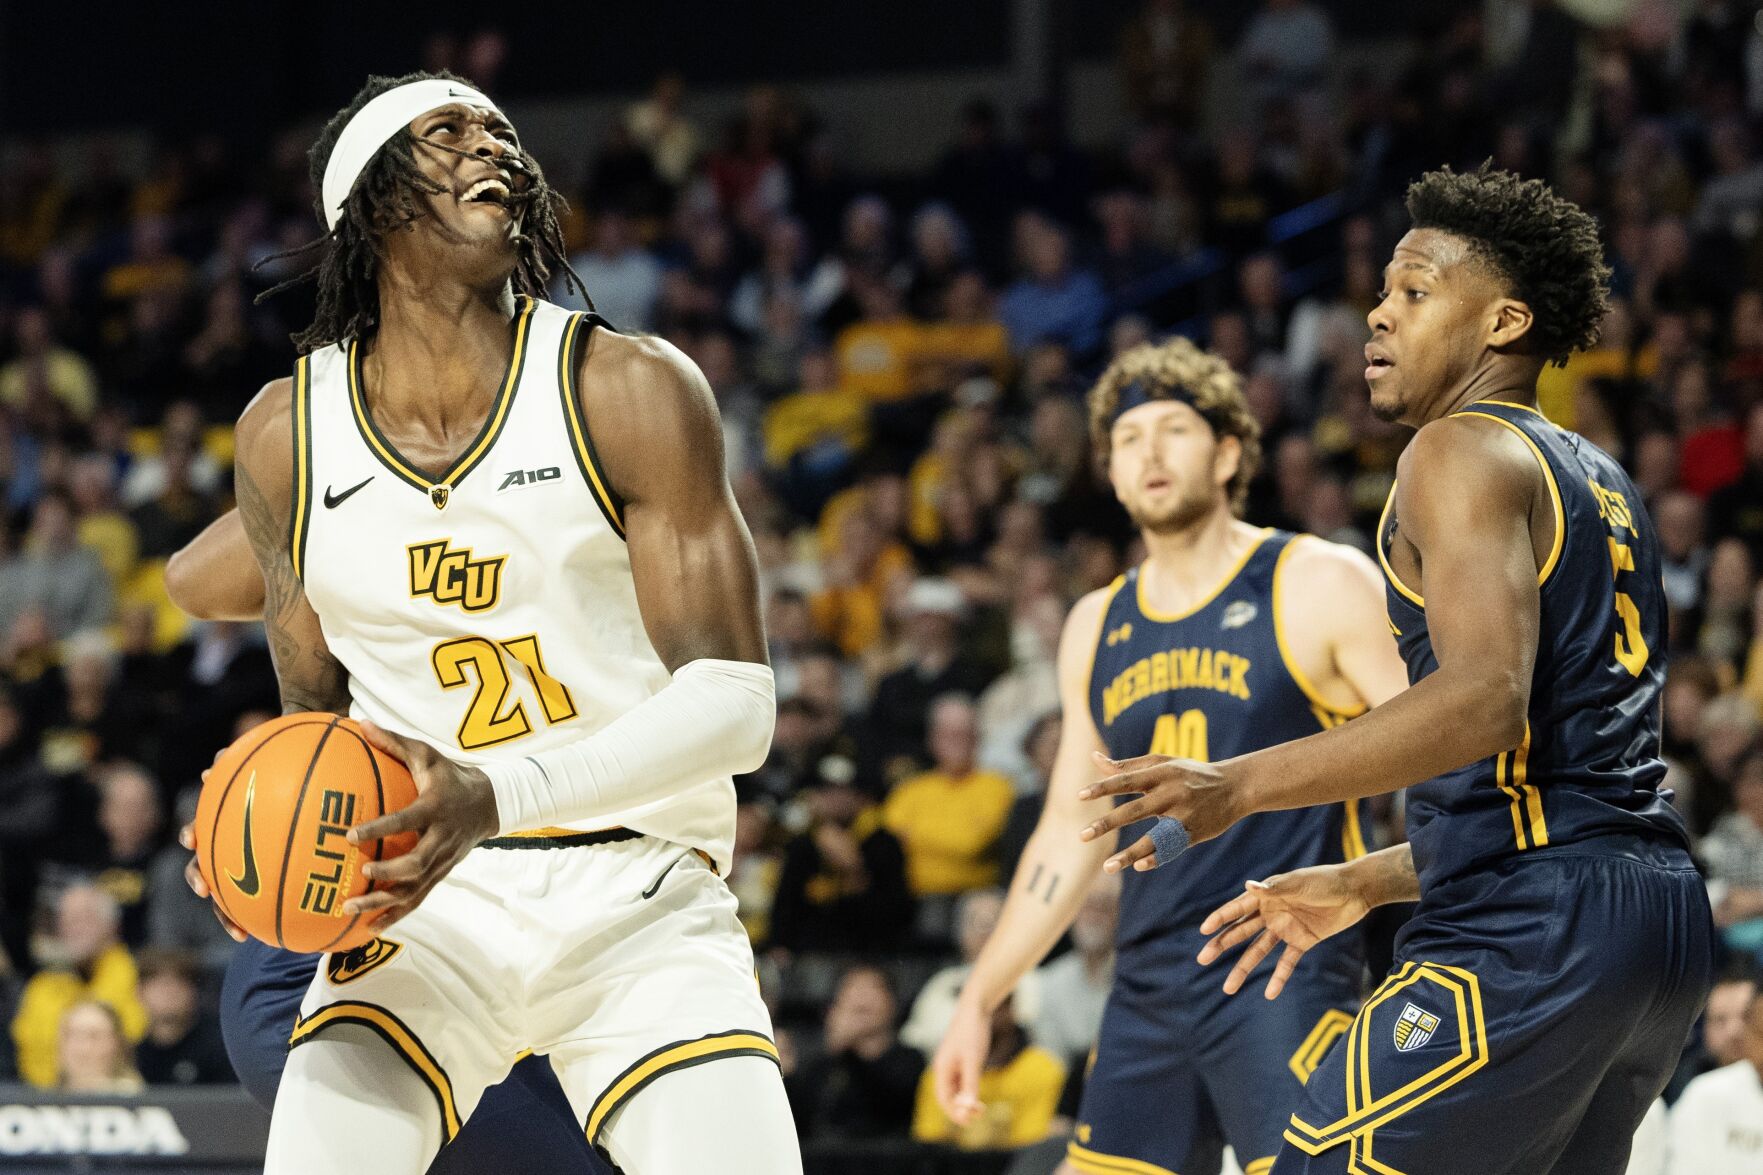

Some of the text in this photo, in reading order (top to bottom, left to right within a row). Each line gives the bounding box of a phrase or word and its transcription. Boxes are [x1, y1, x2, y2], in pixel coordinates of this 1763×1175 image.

[497, 466, 561, 491] A10
[405, 537, 509, 614] VCU
[431, 632, 578, 751] 21
[1103, 647, 1251, 726] MERRIMACK
[299, 788, 356, 915] ELITE
